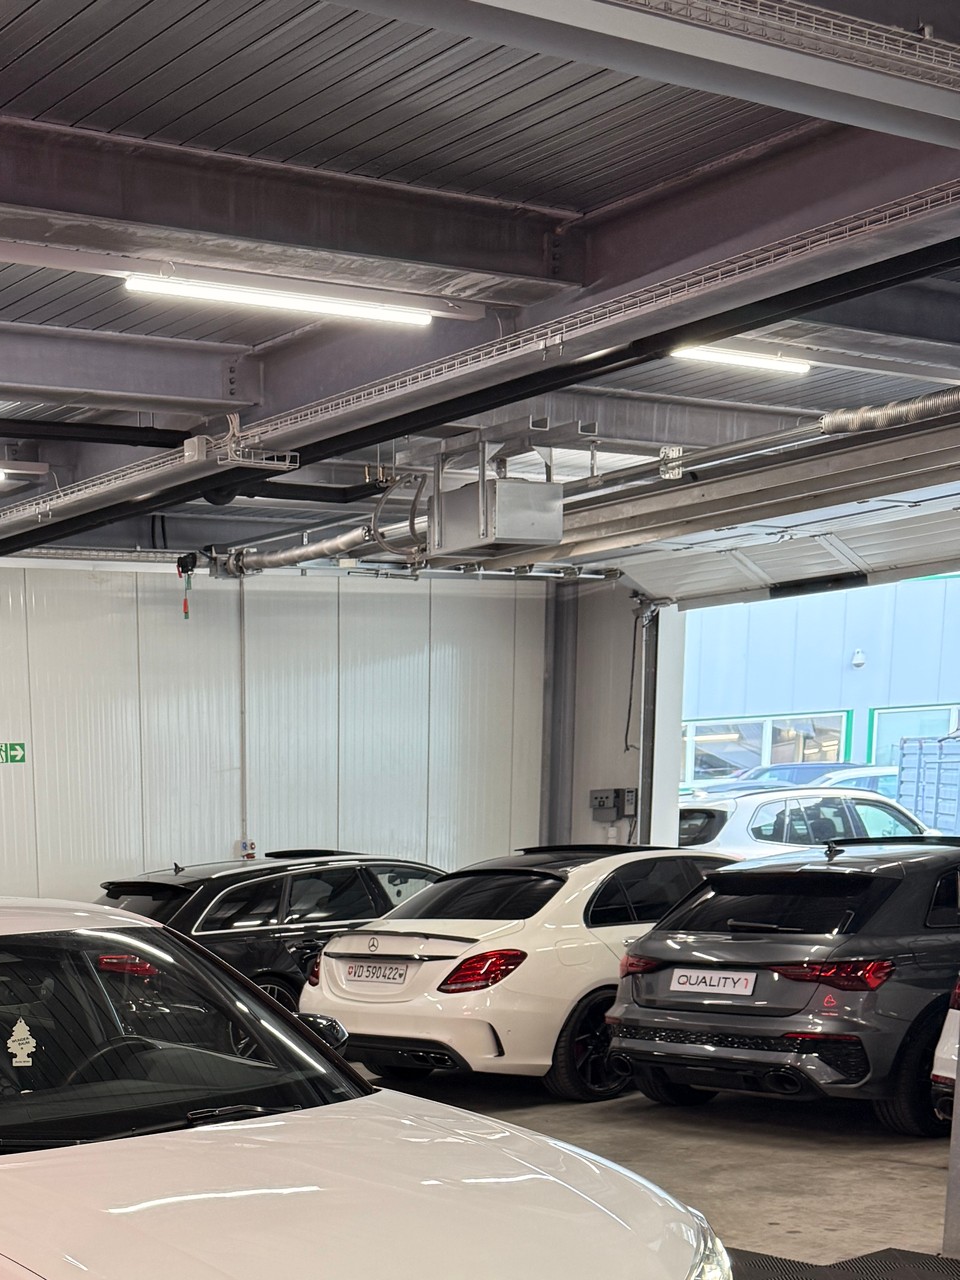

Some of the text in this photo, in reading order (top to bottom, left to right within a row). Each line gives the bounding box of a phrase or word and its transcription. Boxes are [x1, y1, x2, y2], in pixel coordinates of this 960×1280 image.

[353, 964, 364, 978] VD
[677, 974, 749, 989] QUALITY 1
